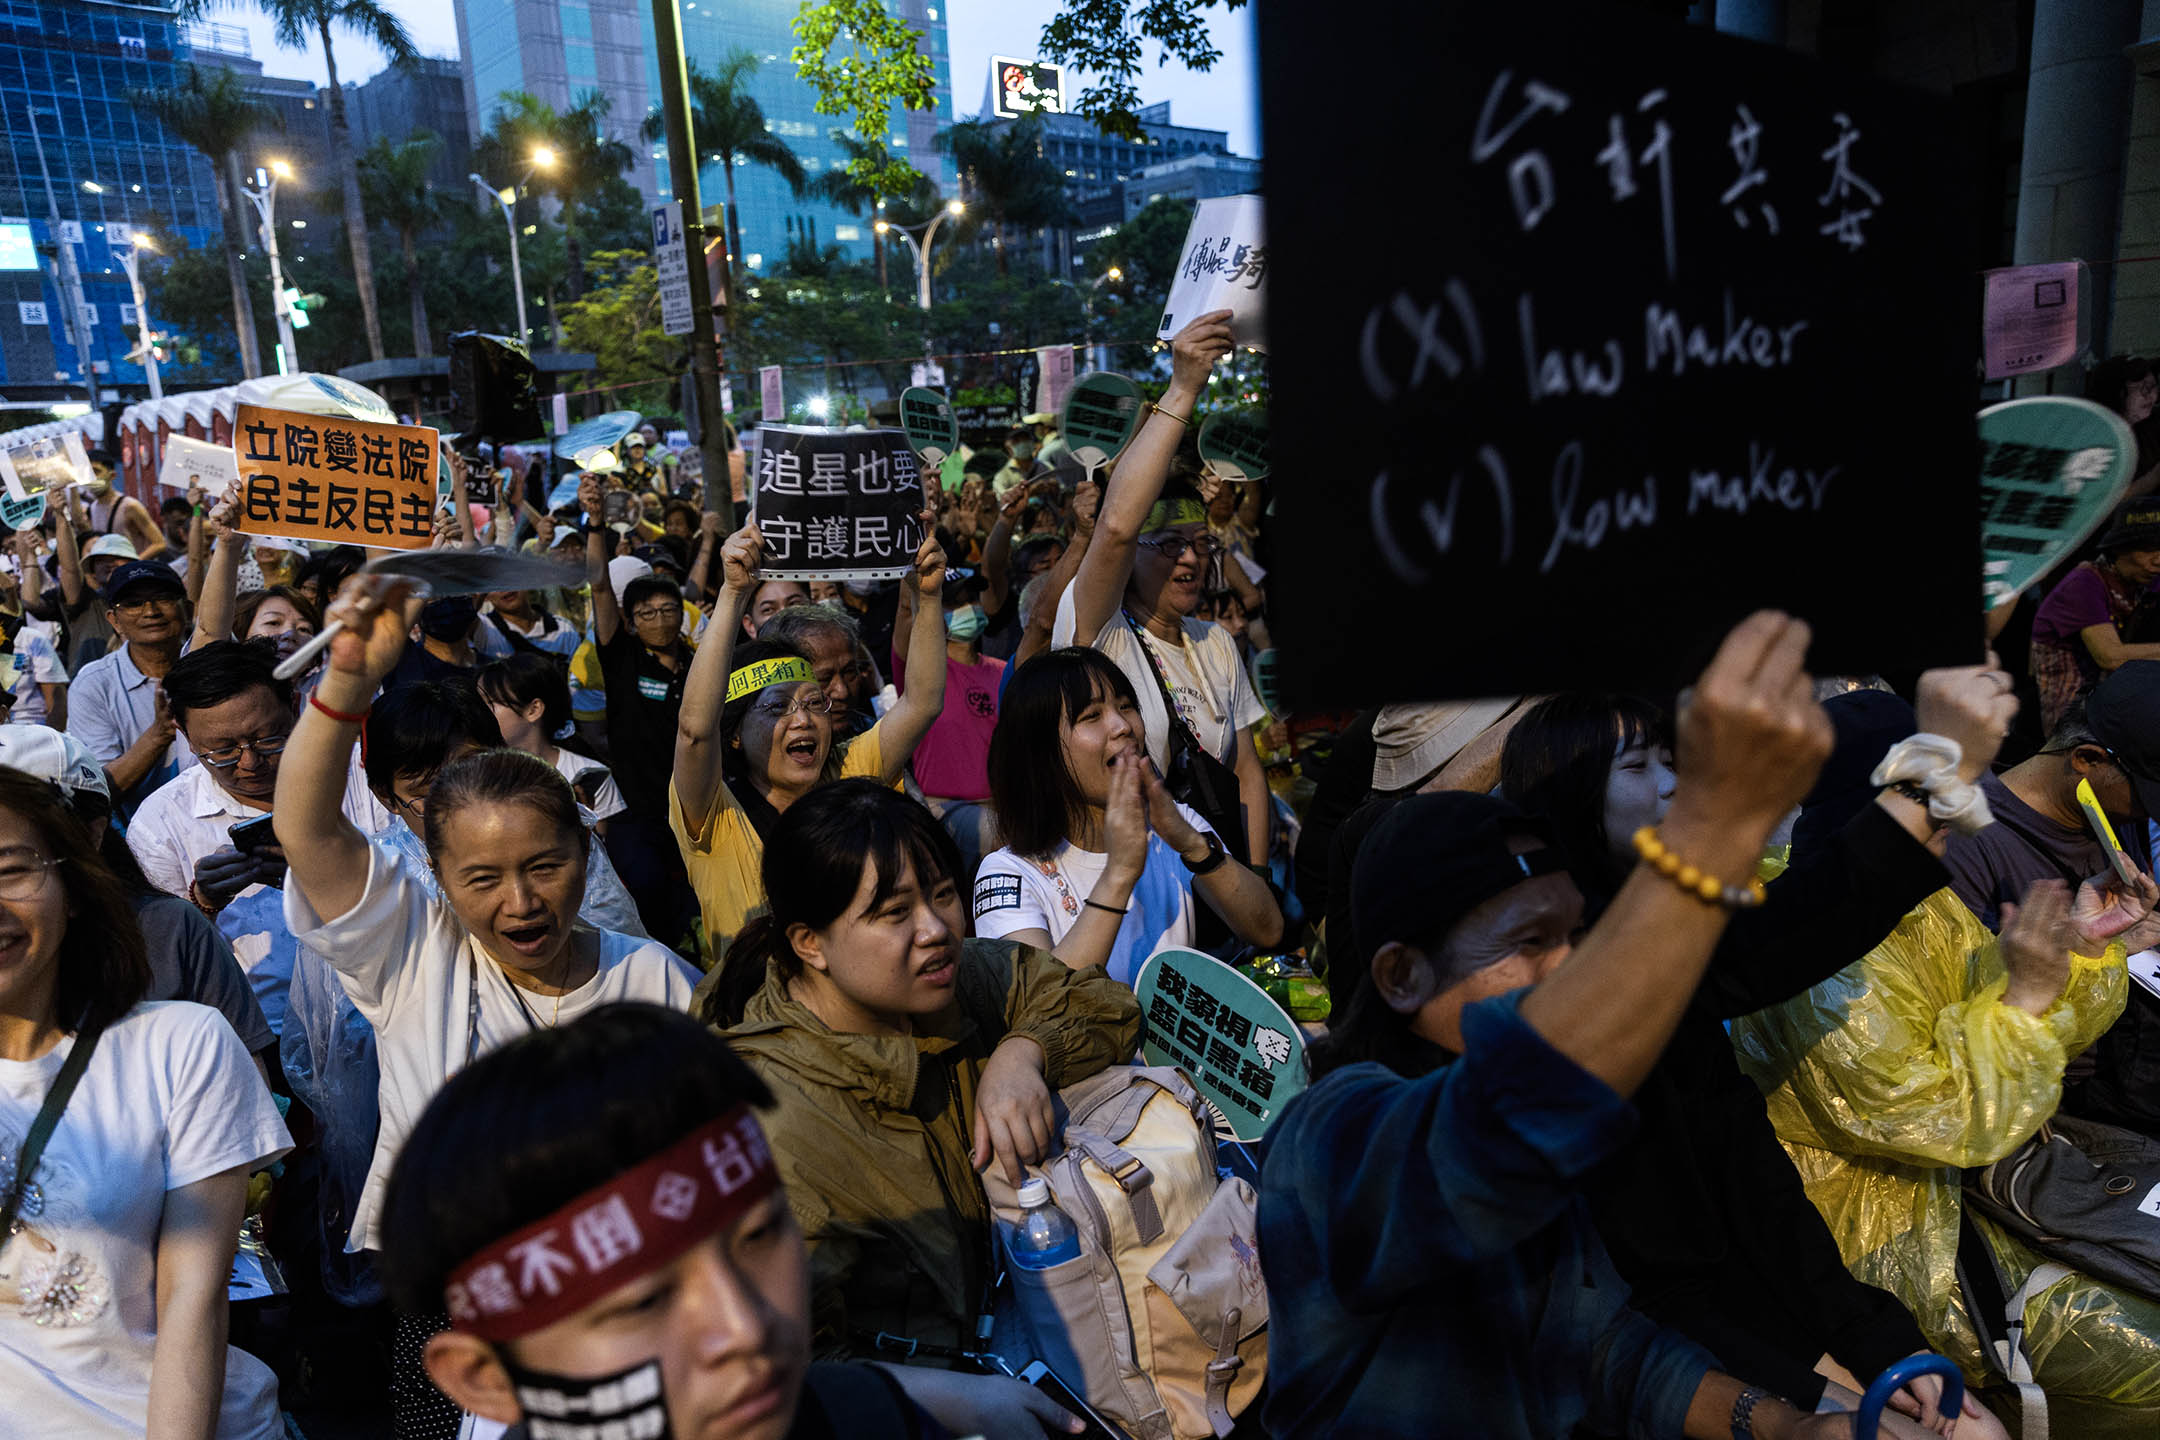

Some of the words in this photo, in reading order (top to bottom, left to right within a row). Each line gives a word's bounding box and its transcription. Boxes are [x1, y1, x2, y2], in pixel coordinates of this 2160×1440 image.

[245, 420, 430, 485] 立院變法院
[759, 448, 920, 496] 追星也要
[247, 474, 430, 537] 民主反民主
[760, 513, 924, 560] 守護民心
[727, 661, 806, 698] 回黑箱！
[1157, 962, 1252, 1048] 我藐視
[1148, 993, 1275, 1100] 藍白黑箱
